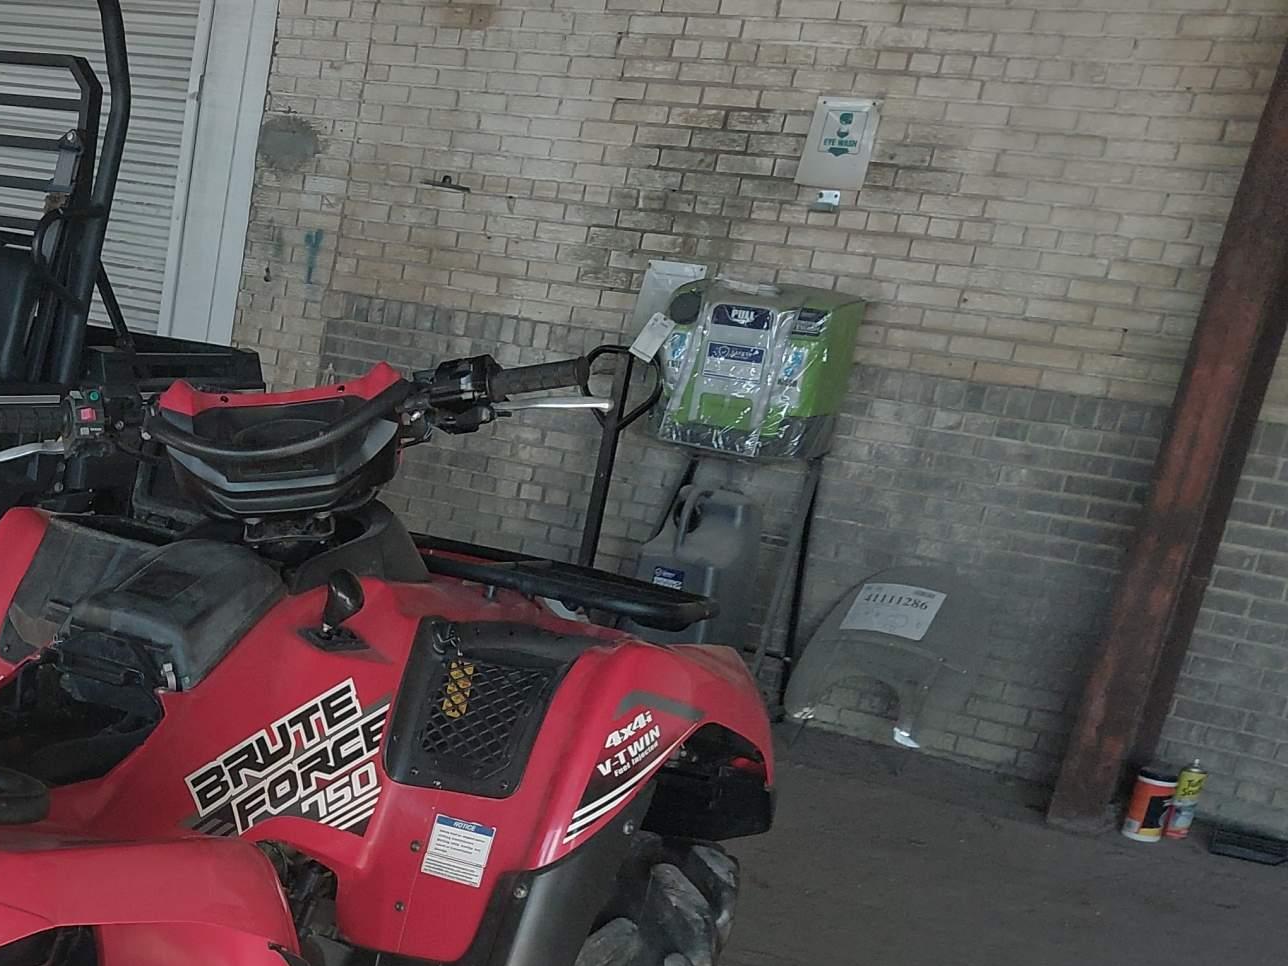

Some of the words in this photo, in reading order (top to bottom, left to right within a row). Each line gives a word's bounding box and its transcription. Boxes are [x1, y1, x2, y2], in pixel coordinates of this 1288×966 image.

[823, 138, 835, 146] EYE
[837, 139, 858, 148] WASH
[730, 308, 757, 321] PULL
[184, 677, 363, 818] BRUTE
[604, 710, 653, 749] 4x4i
[230, 702, 392, 837] FORCE
[596, 724, 661, 777] V-TWIN
[613, 761, 631, 778] Fuel
[631, 740, 659, 766] Injected
[300, 761, 379, 818] 750
[452, 821, 477, 831] NOTICE
